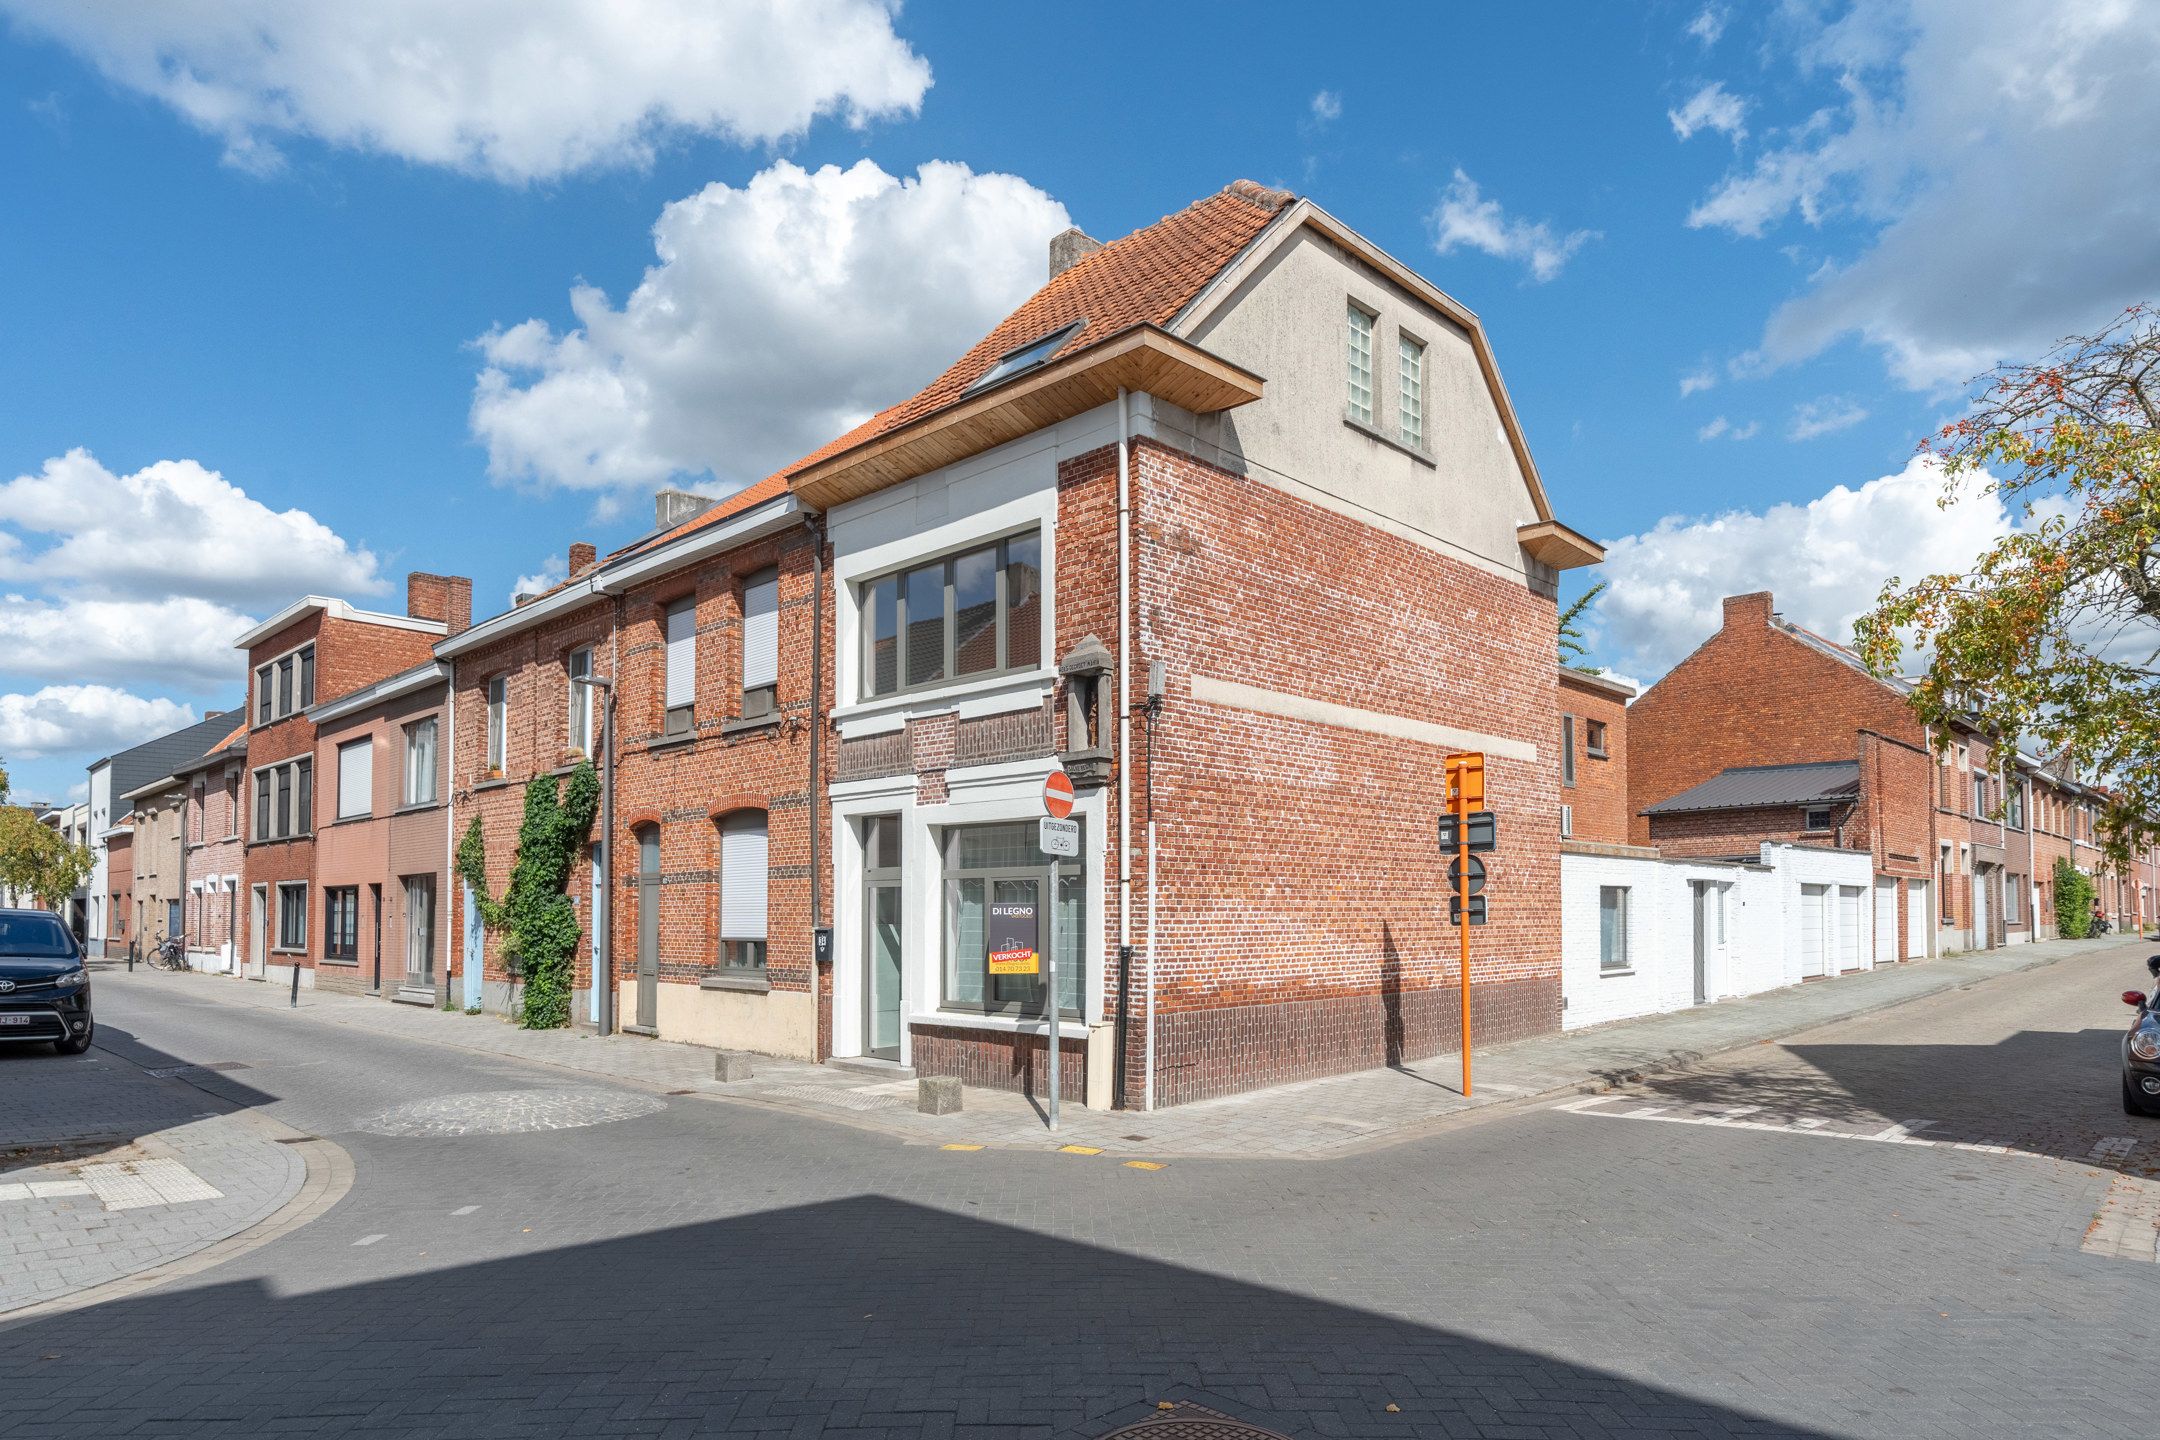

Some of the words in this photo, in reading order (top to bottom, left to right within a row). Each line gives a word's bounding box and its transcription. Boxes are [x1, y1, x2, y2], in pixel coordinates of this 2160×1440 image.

[1043, 821, 1077, 834] UITGEZONDERD
[992, 907, 1002, 915] DI
[1003, 907, 1033, 915] LEGNO
[992, 950, 1032, 961] VERKOCHT
